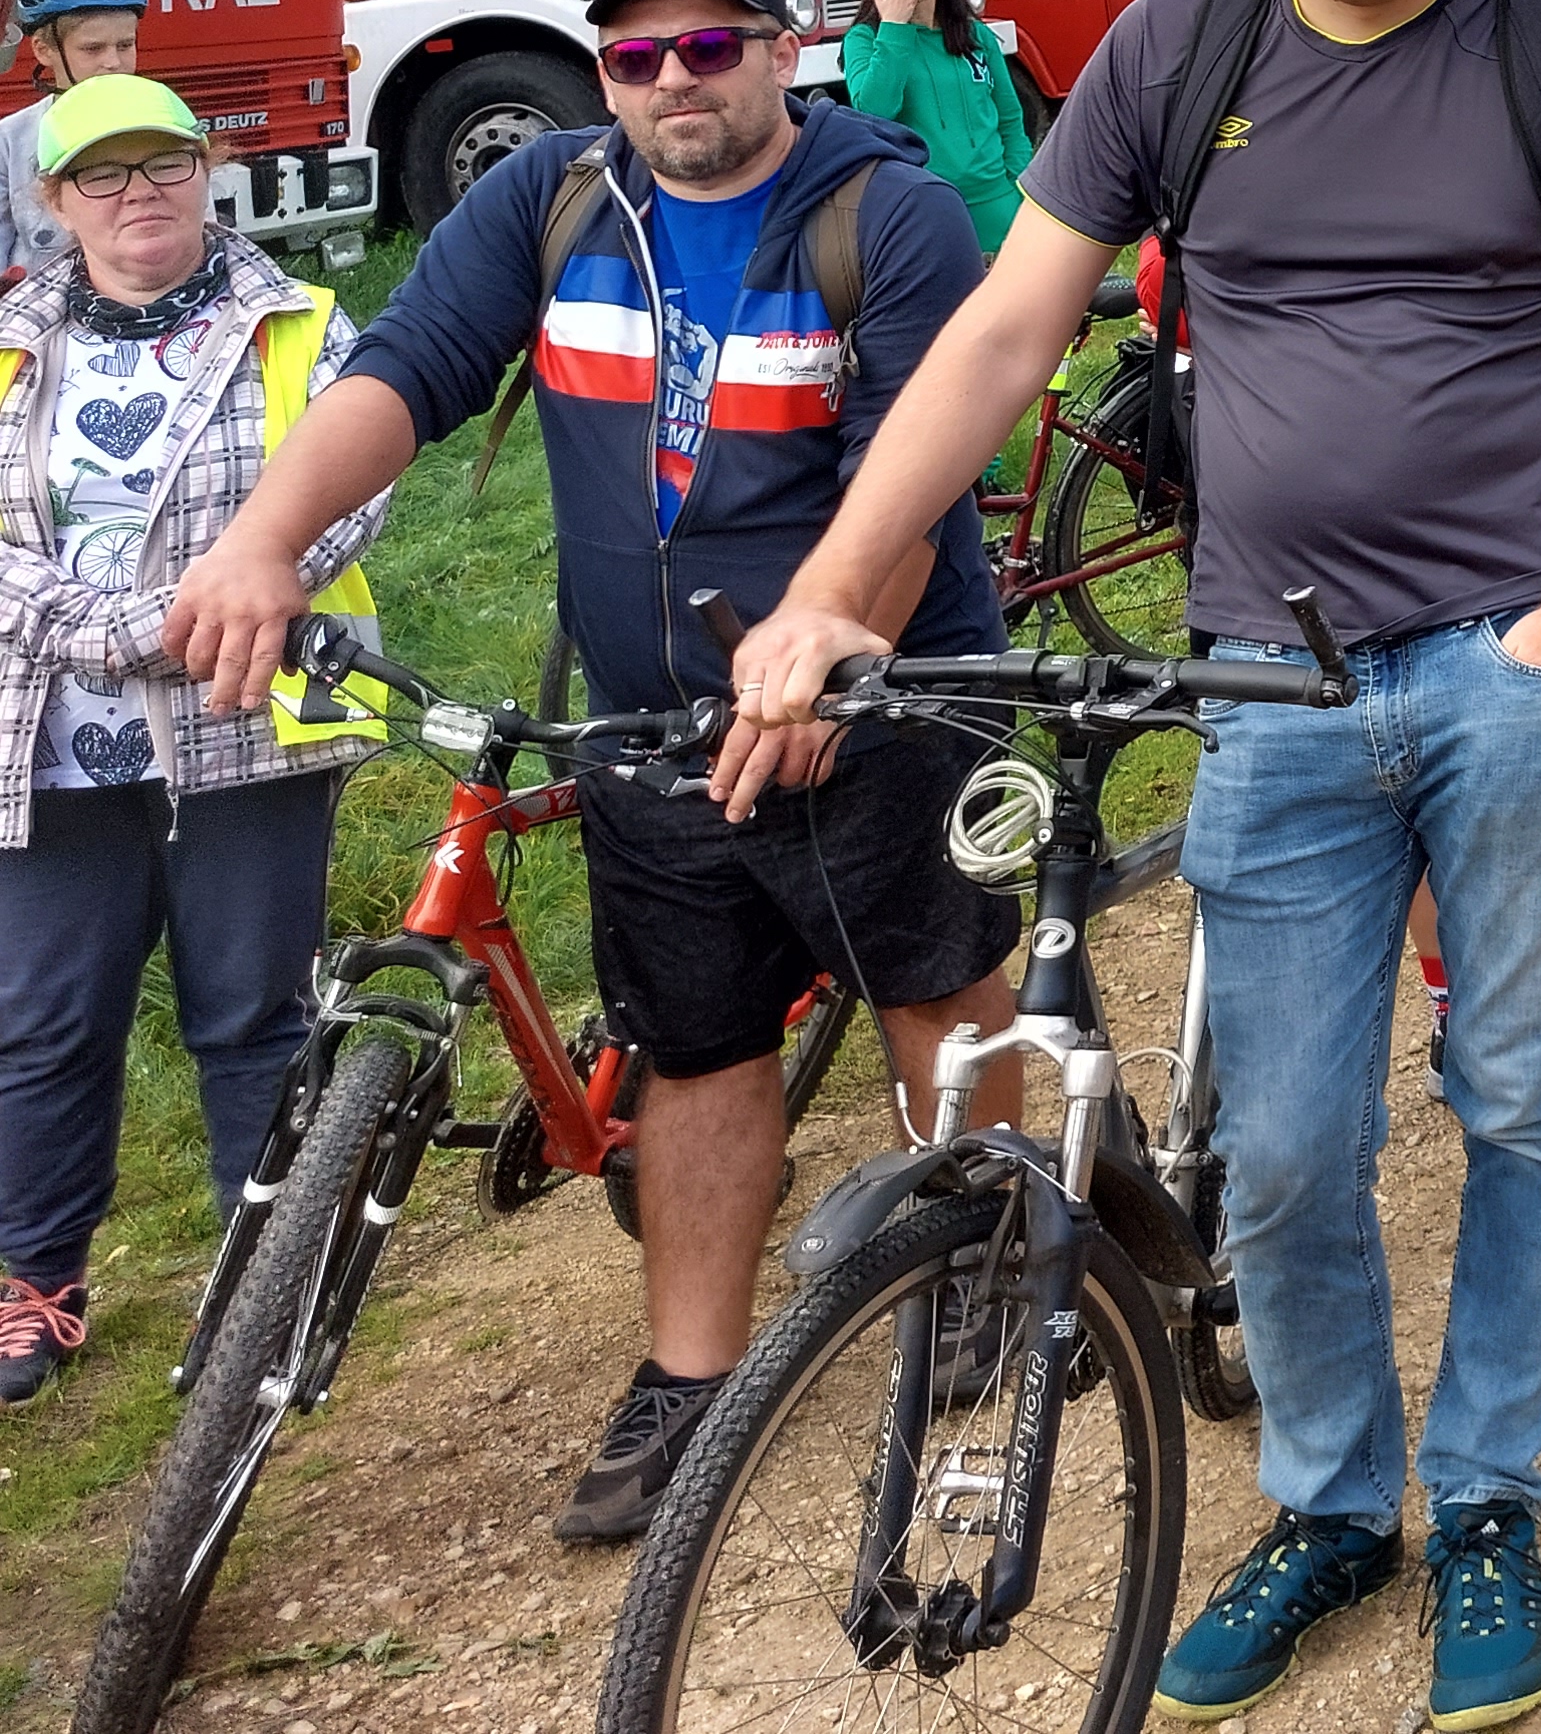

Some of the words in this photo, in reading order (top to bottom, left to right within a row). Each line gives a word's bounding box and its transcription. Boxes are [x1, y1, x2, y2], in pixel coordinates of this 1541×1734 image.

[215, 112, 269, 131] DEUTZ
[326, 121, 345, 136] 170
[1214, 138, 1249, 150] mbro
